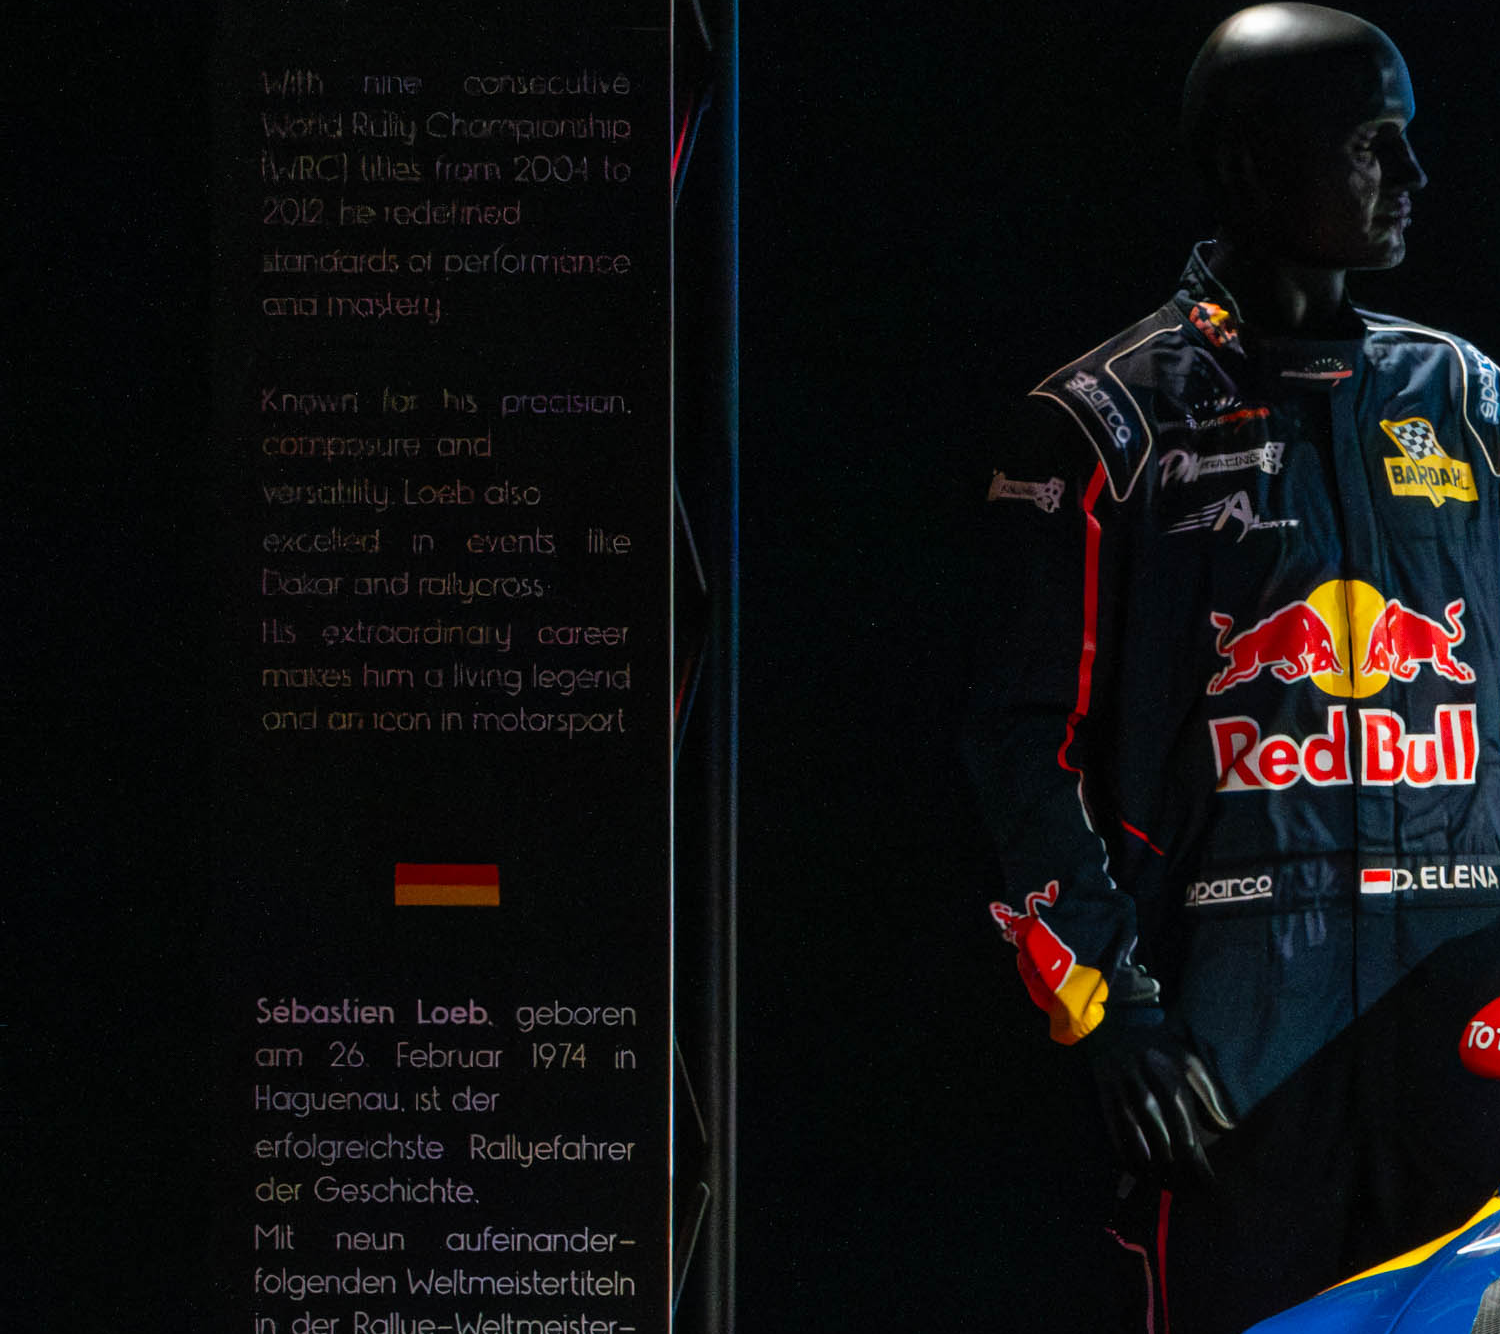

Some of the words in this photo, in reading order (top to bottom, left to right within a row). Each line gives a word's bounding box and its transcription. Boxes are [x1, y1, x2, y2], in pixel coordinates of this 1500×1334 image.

[1393, 864, 1500, 891] D.ELENA
[256, 997, 395, 1025] Sébastien
[416, 998, 493, 1026] Loeb,
[515, 999, 637, 1033] geboren
[254, 1047, 303, 1068] am
[396, 1040, 503, 1069] Februar
[532, 1042, 587, 1069] 1974
[614, 1043, 637, 1070] in
[414, 1085, 441, 1112] ist
[451, 1085, 500, 1113] der
[255, 1131, 445, 1167] erfolgreichste
[469, 1133, 635, 1168] Rallyefahrer
[254, 1176, 302, 1204] der
[313, 1175, 480, 1204] Geschichte.
[254, 1224, 295, 1250] Mit
[335, 1231, 405, 1252] neun
[445, 1225, 635, 1253] aufeinander-
[254, 1267, 397, 1301] folgenden
[406, 1268, 636, 1297] Weltmeistertiteln
